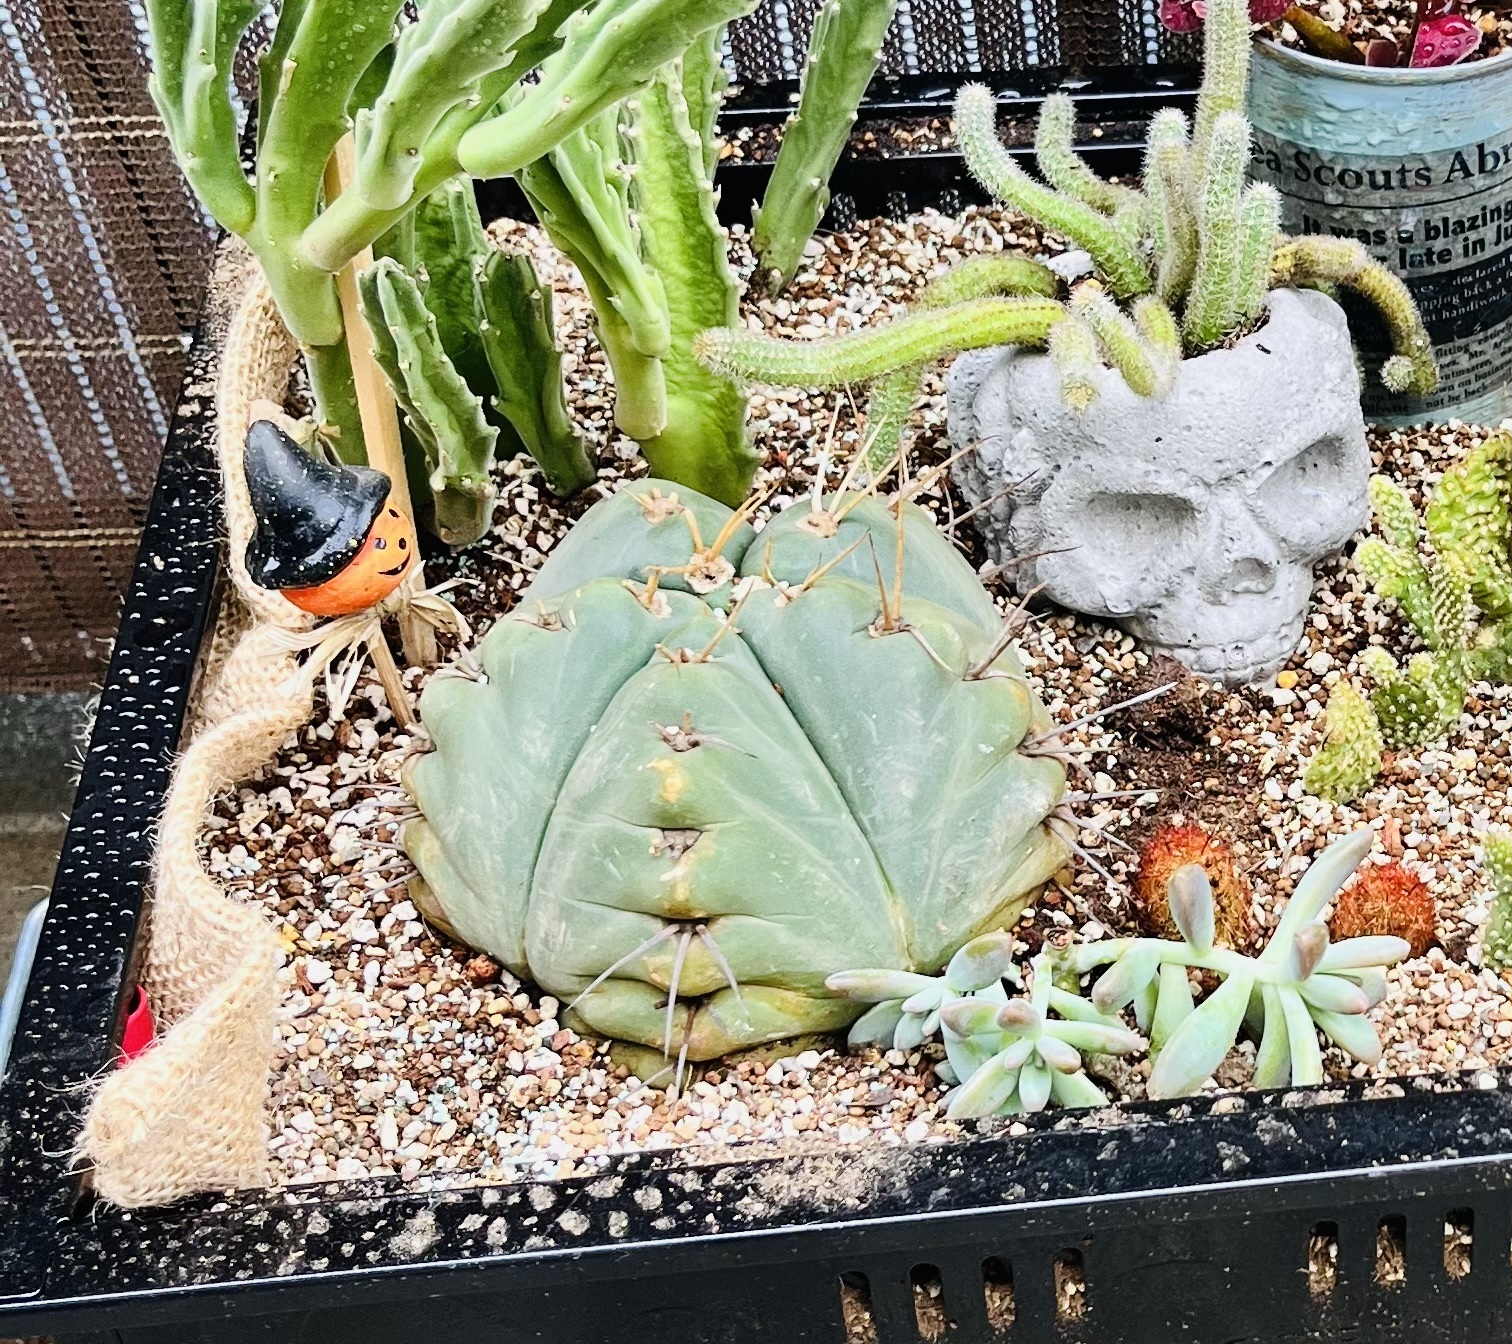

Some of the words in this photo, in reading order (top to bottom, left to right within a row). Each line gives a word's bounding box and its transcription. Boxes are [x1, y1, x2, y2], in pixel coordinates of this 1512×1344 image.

[1250, 139, 1283, 174] ea
[1294, 150, 1432, 191] Scouts
[1329, 224, 1388, 246] was
[1398, 229, 1414, 244] a
[1399, 247, 1453, 270] late
[1462, 236, 1486, 258] in
[1420, 294, 1460, 312] pping
[1464, 280, 1493, 298] back
[1458, 379, 1472, 389] on
[1425, 397, 1445, 409] not
